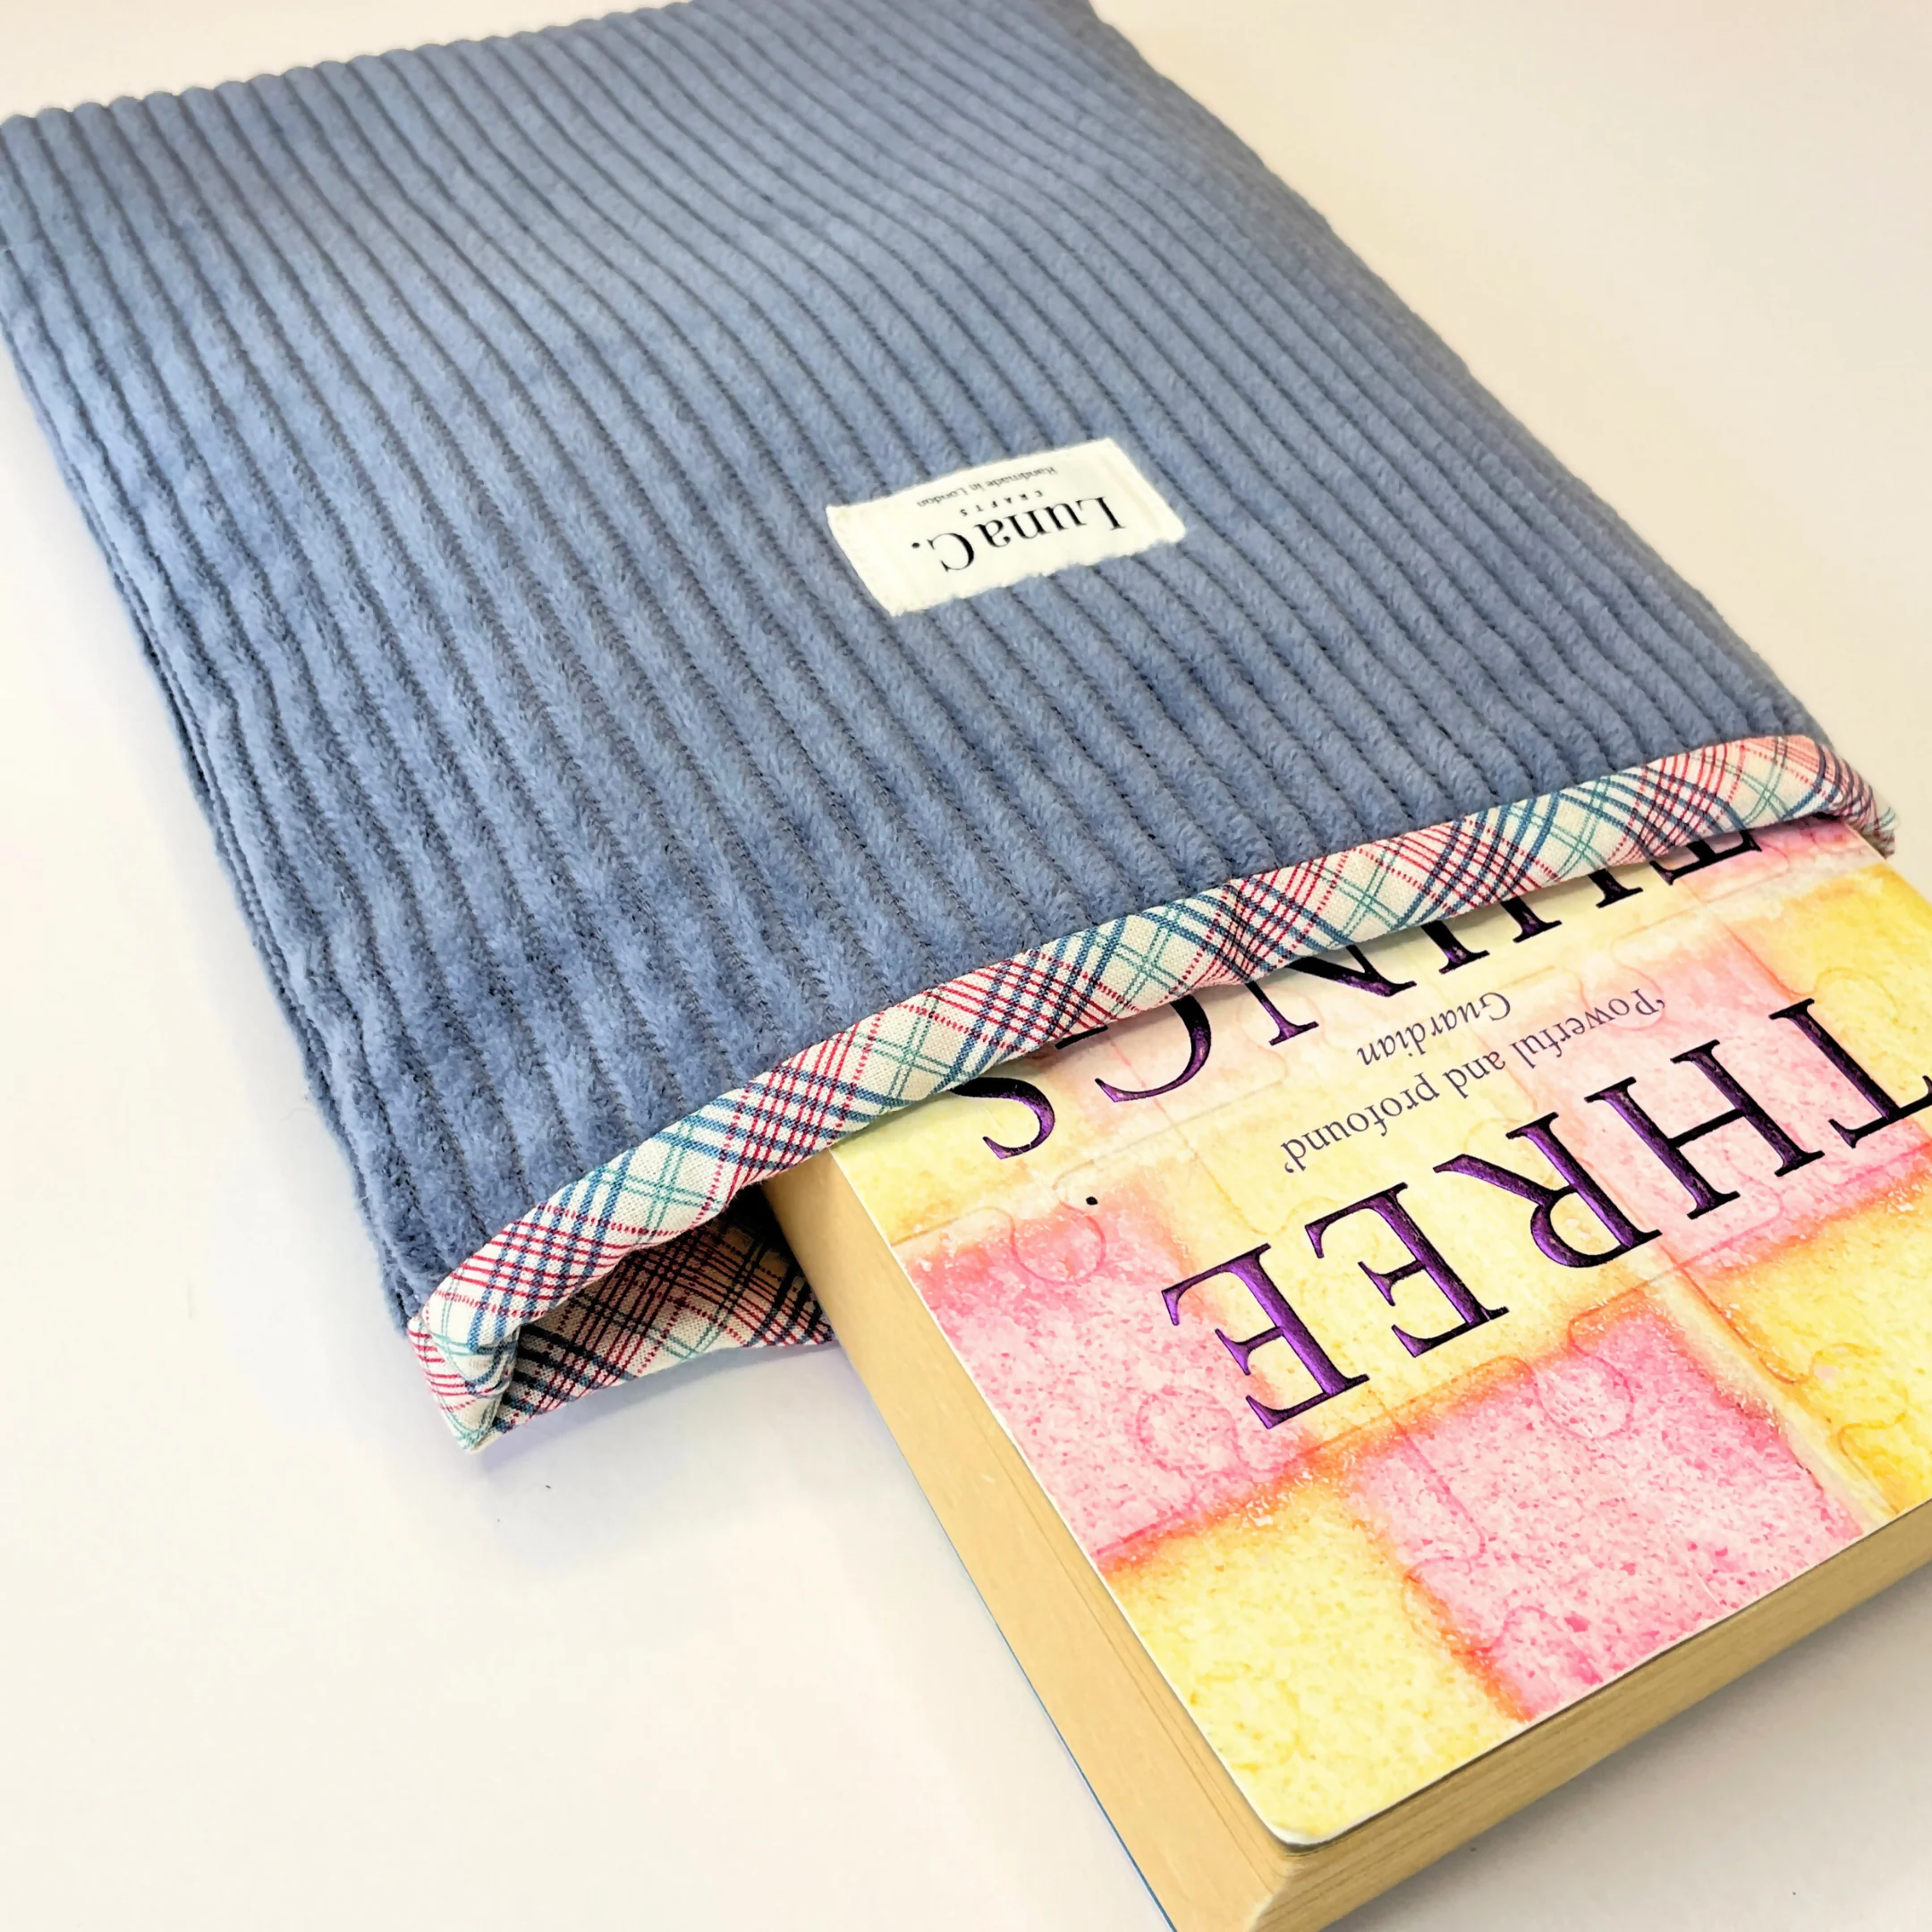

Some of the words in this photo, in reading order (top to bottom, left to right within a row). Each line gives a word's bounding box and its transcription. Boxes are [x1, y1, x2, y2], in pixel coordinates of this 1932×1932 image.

[969, 483, 984, 492] in
[986, 466, 1058, 487] Handmade
[917, 487, 969, 507] London
[960, 489, 1044, 516] CRAFTS
[974, 496, 1126, 548] Luna
[1357, 991, 1512, 1065] Guardian
[1442, 1049, 1505, 1099] and
[1162, 998, 1932, 1429] THREE
